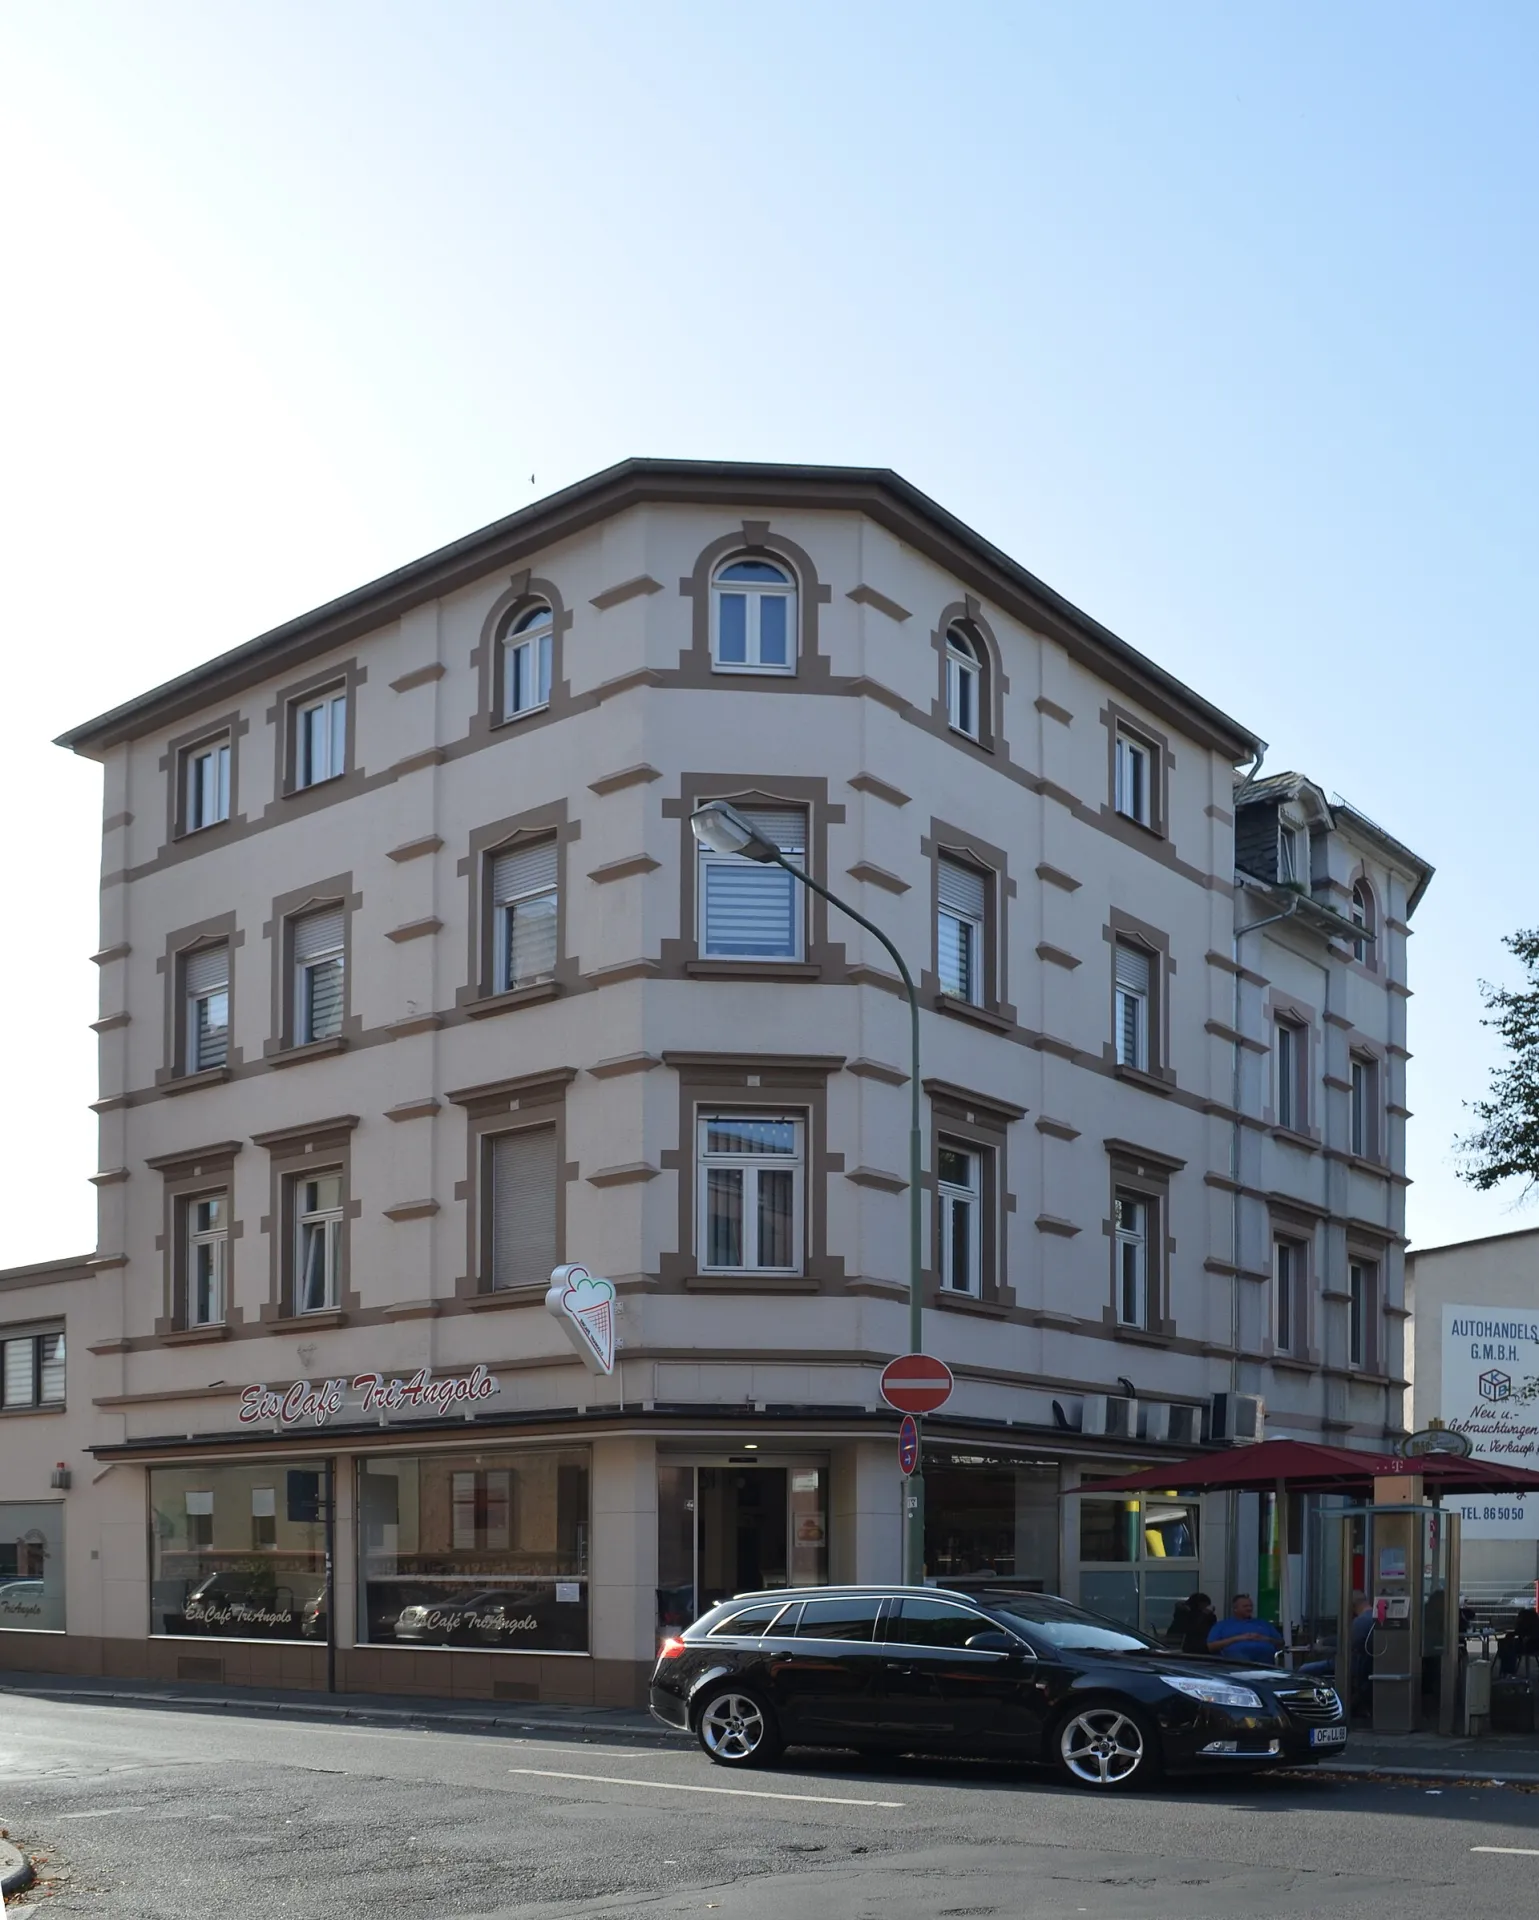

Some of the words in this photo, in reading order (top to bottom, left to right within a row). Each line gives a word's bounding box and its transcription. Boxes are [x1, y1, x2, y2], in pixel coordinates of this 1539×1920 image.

[1451, 1319, 1538, 1341] AUTOHANDELS
[1470, 1343, 1520, 1362] G.M.B.H.
[352, 1364, 500, 1416] TriAngolo
[1470, 1404, 1496, 1419] Neu
[1448, 1418, 1539, 1441] Gebrauchtwagen
[1461, 1506, 1482, 1520] TEL.
